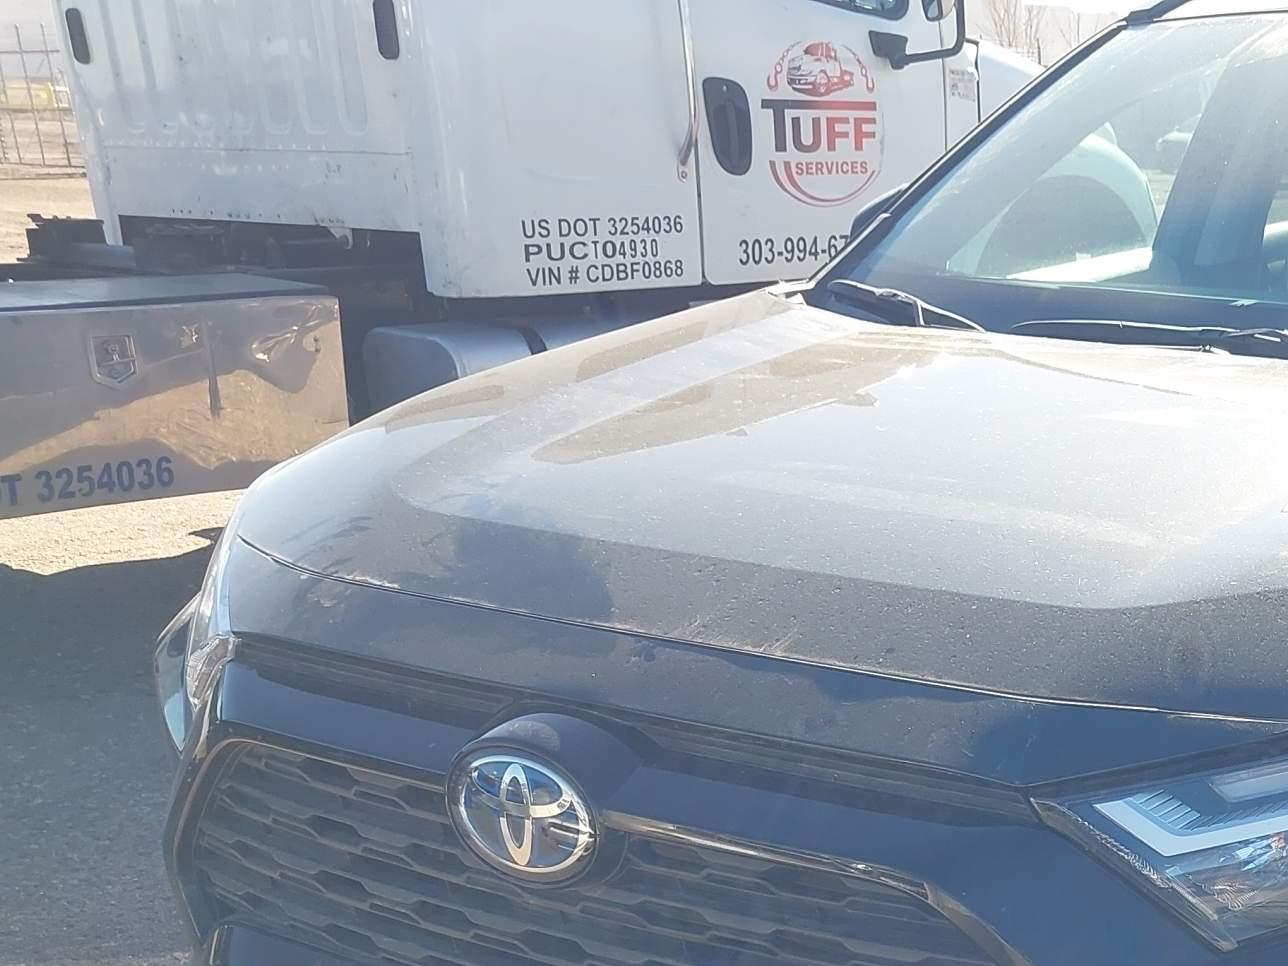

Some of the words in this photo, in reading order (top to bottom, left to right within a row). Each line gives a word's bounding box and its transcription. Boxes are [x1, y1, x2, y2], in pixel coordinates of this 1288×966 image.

[761, 98, 877, 153] TUFF
[795, 160, 868, 176] SERVICES
[521, 219, 551, 239] US
[558, 217, 600, 238] DOT
[607, 215, 684, 236] 3254036
[526, 266, 562, 287] VIN
[568, 265, 580, 285] #
[586, 259, 684, 283] CDBF0868
[0, 473, 22, 506] T
[35, 456, 174, 502] 3254036
